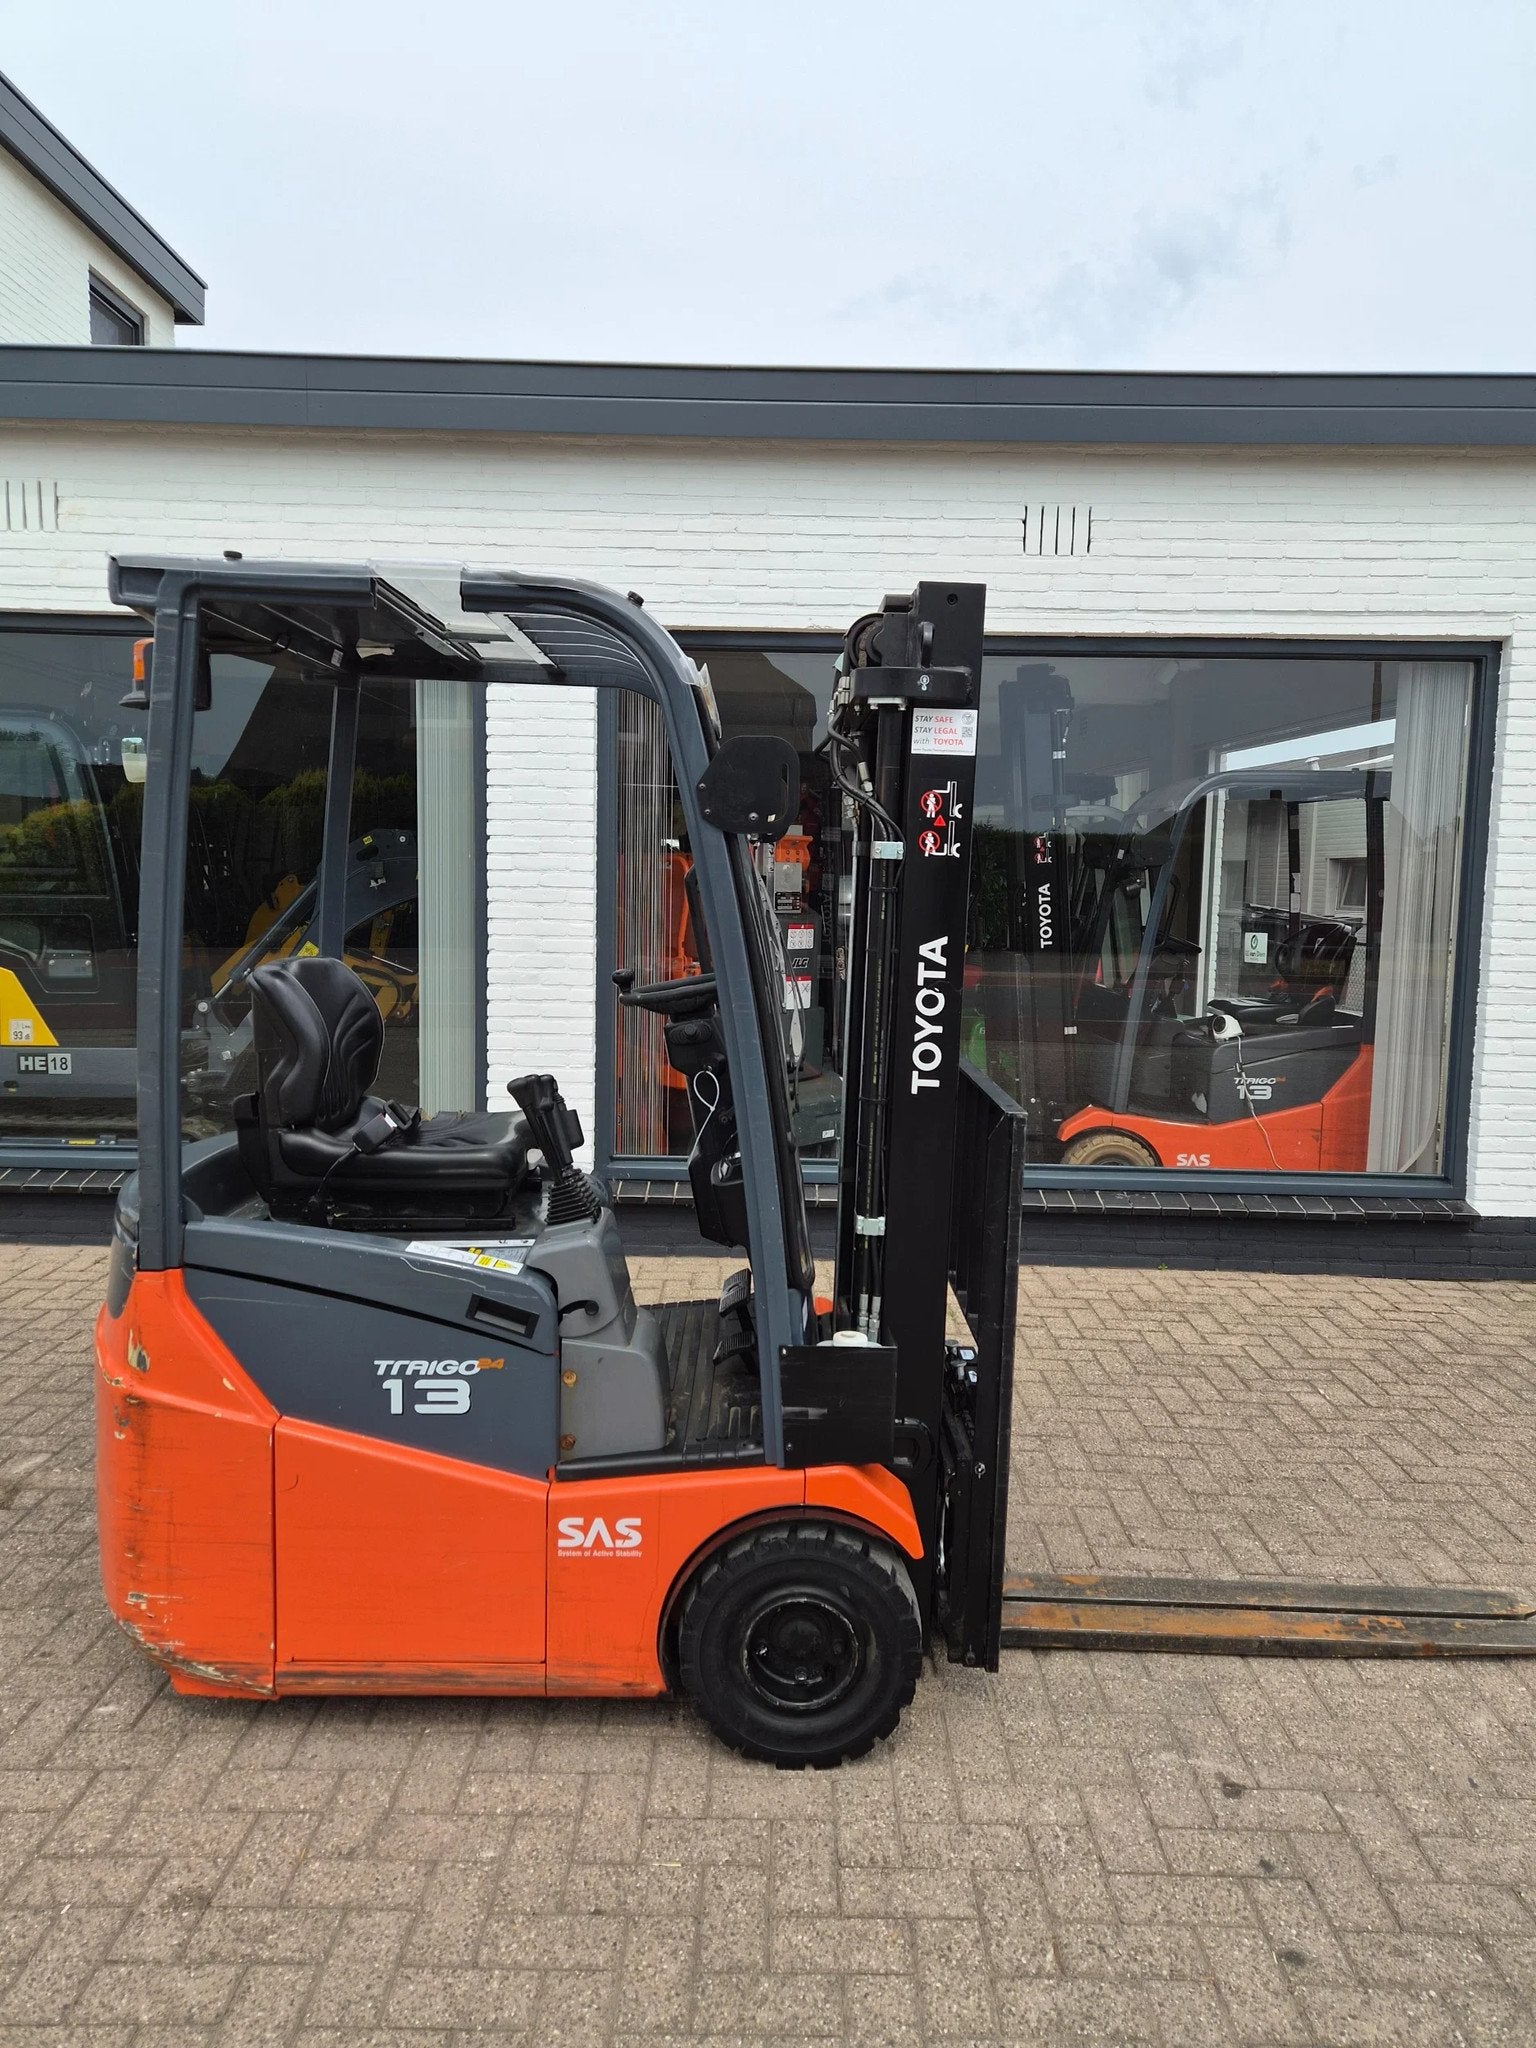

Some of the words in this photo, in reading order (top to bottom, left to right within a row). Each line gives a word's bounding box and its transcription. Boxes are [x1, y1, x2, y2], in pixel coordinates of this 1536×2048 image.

[914, 715, 933, 723] STAY
[934, 715, 954, 723] SAFE
[913, 726, 933, 734] STAY
[934, 727, 958, 735] LEGAL
[913, 737, 930, 745] with
[933, 737, 964, 746] TOYOTA
[1038, 883, 1053, 949] TOYOTA
[911, 936, 949, 1095] TOYOTA
[1236, 1085, 1272, 1100] 13
[1176, 1153, 1211, 1167] SAS
[382, 1378, 471, 1415] 13
[558, 1517, 643, 1549] SAS
[558, 1549, 583, 1557] System
[615, 1550, 643, 1558] Stability
